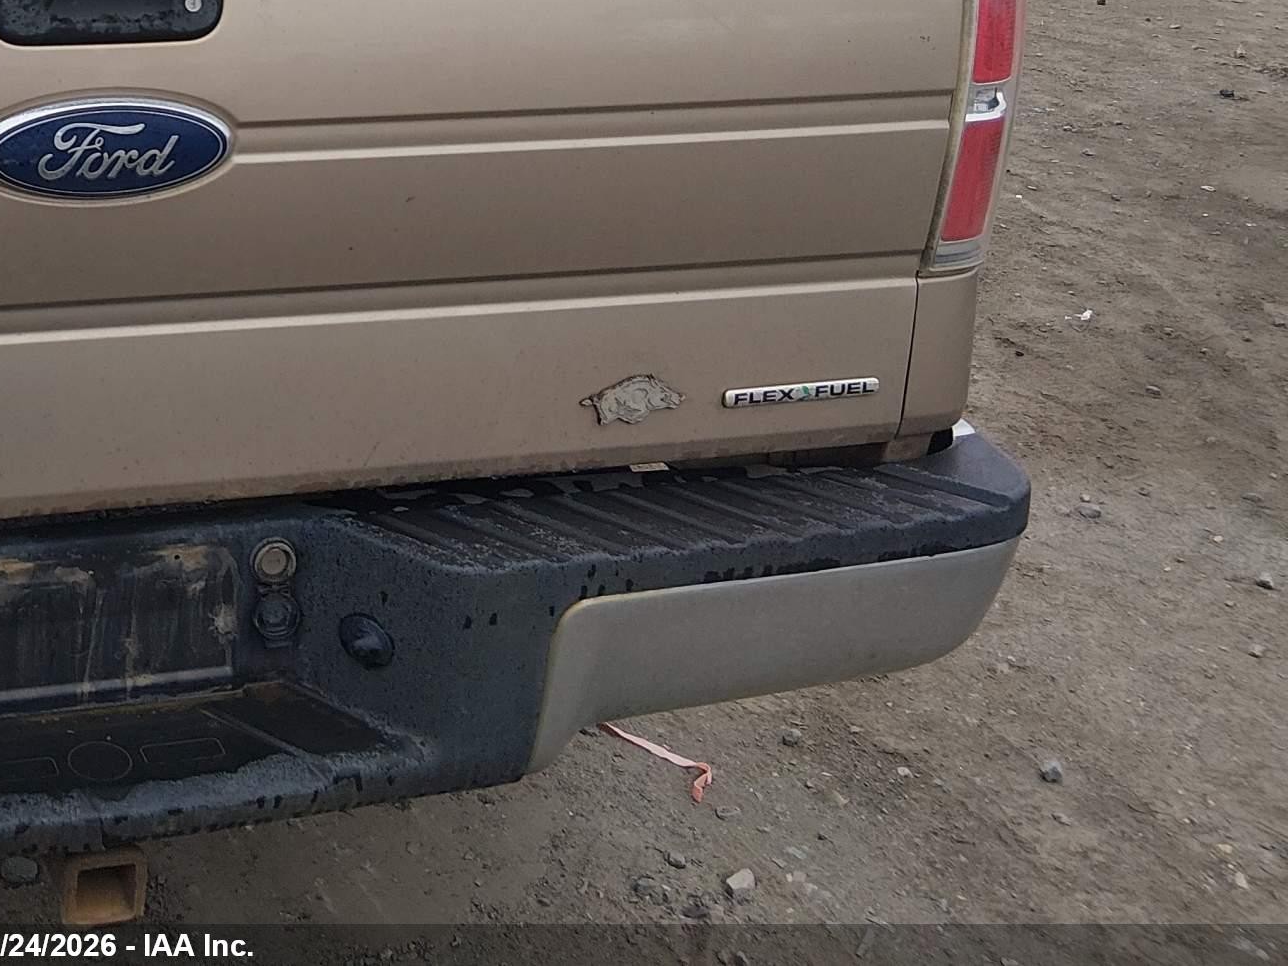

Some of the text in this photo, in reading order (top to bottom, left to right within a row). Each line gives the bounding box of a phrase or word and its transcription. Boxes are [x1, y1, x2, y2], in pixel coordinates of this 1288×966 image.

[38, 122, 180, 181] Ford
[733, 381, 875, 406] FLEX FUEL
